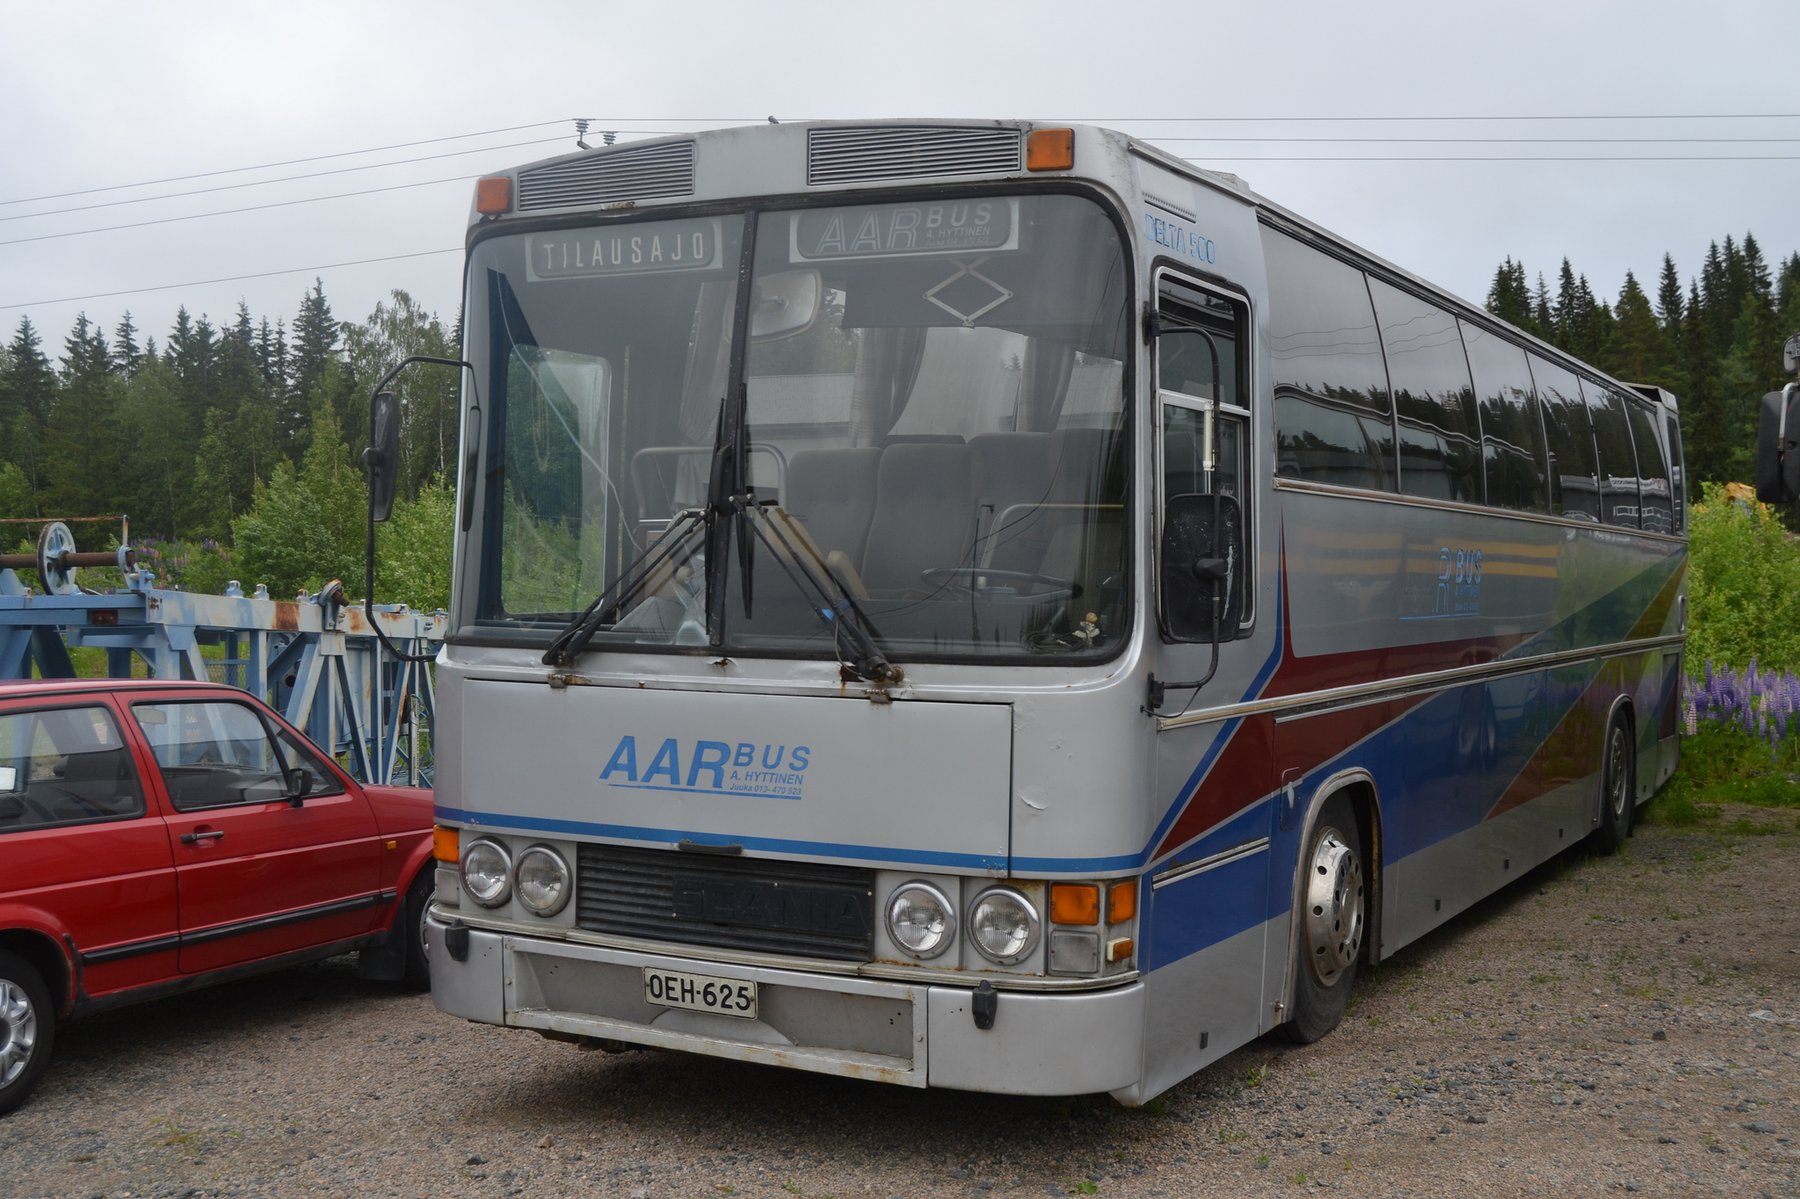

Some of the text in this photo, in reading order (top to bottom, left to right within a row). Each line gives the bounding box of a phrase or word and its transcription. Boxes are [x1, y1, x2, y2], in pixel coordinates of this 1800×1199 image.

[543, 231, 704, 270] TILAUSAJO
[938, 225, 991, 239] HYTTINEN
[1144, 213, 1216, 265] DELTA 500
[598, 735, 812, 789] AAR BUS
[730, 770, 804, 785] A. HYTTINEN
[649, 974, 752, 1011] OEH-625
